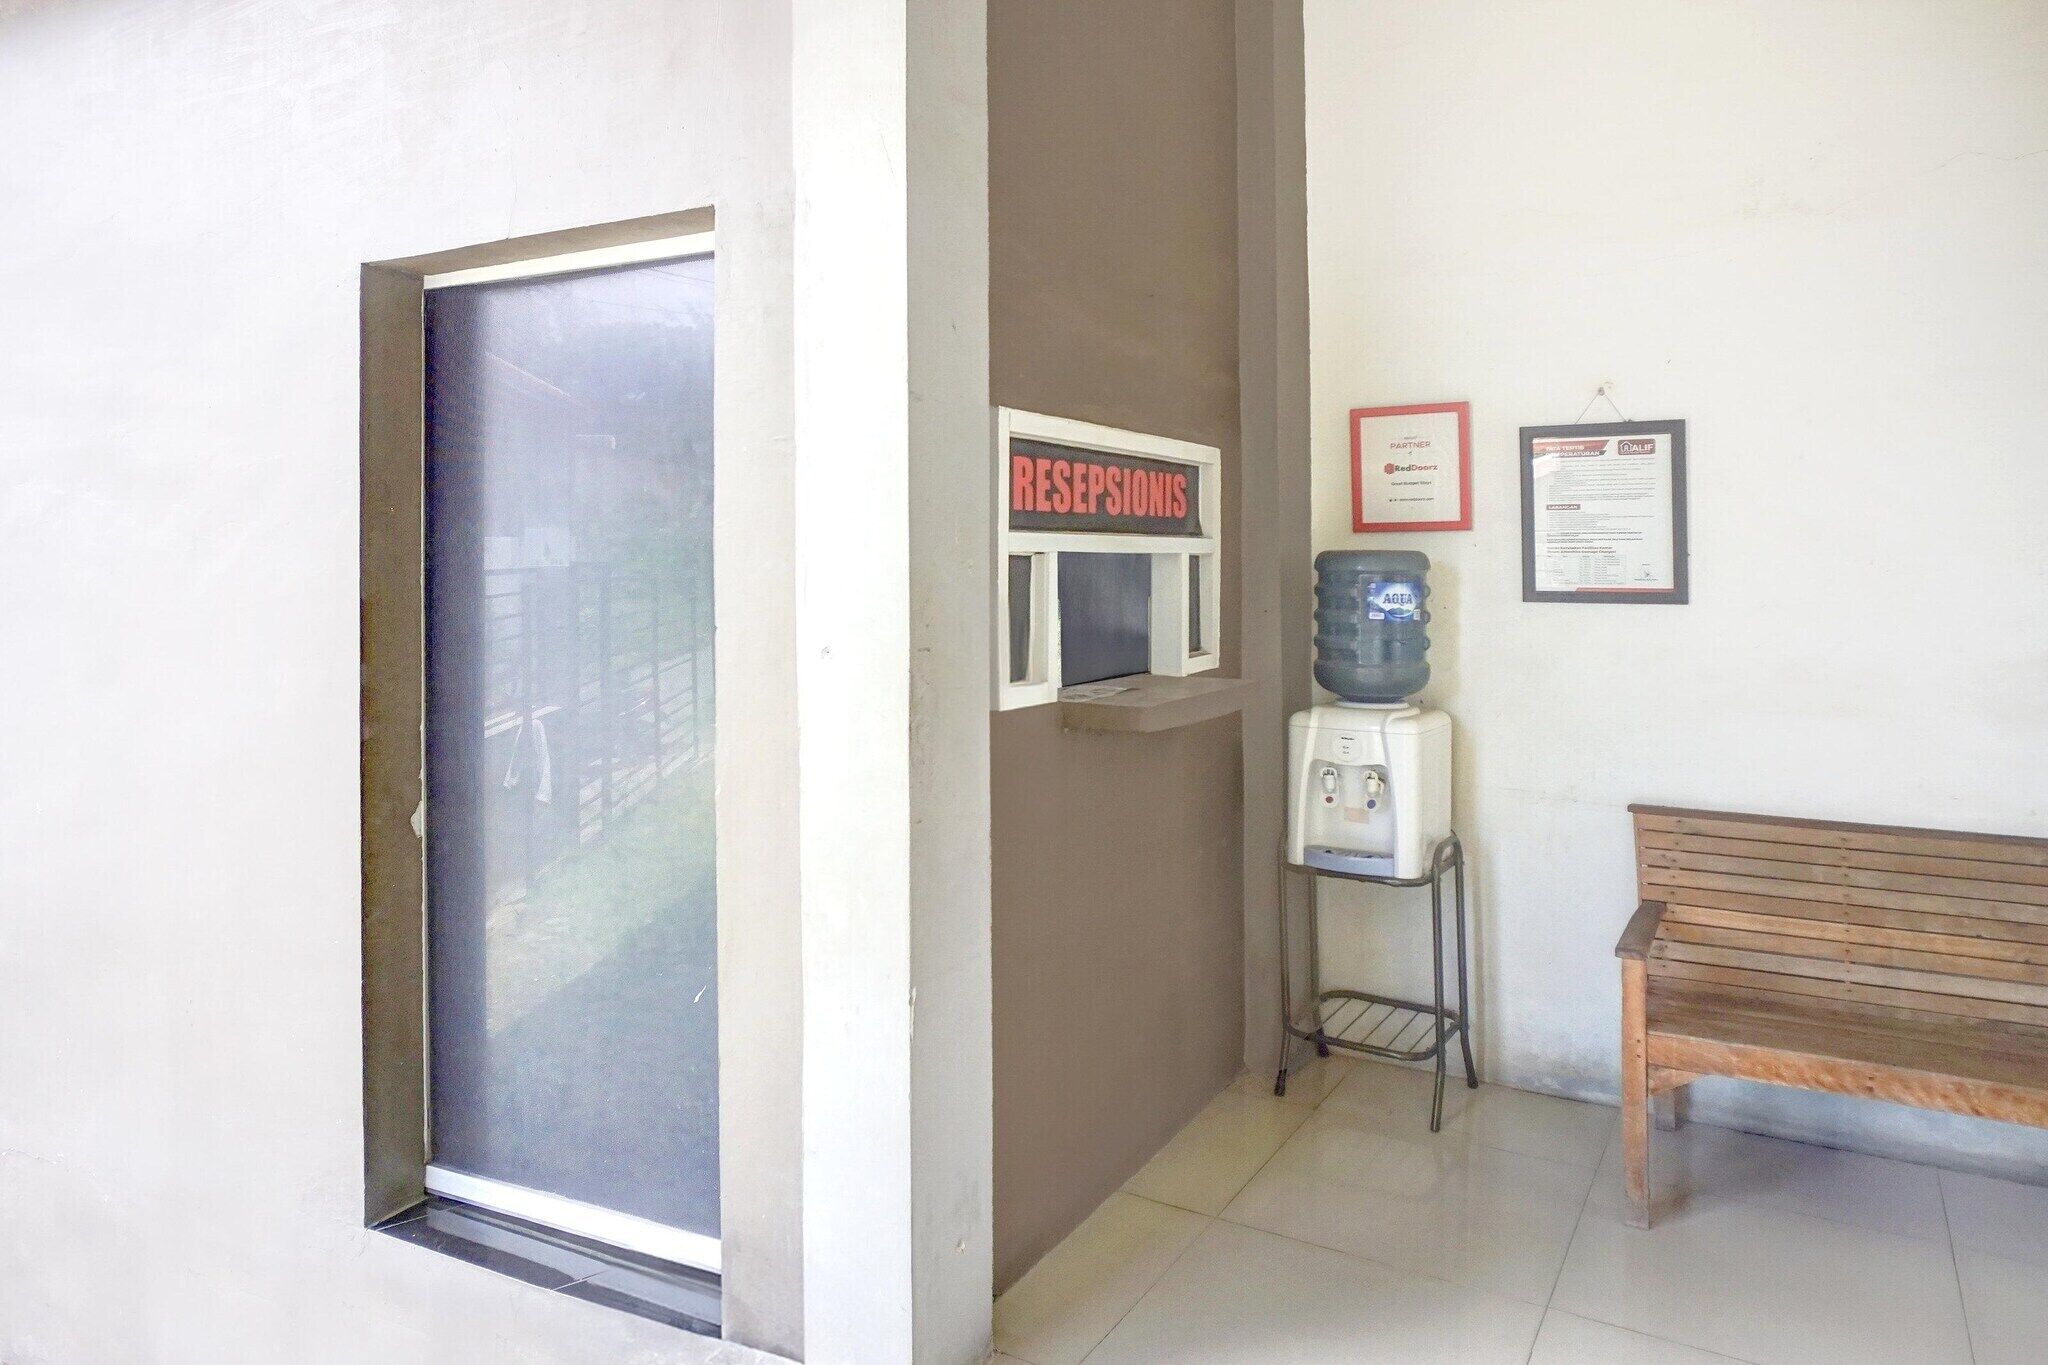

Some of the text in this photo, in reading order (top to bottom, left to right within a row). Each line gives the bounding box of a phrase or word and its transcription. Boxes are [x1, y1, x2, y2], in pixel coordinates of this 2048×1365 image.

[1390, 441, 1431, 449] PARTNER
[1632, 443, 1654, 451] ALIF
[1394, 464, 1438, 472] RedDoorz
[1012, 455, 1188, 519] RESEPSIONIS
[1382, 593, 1413, 605] AQUA
